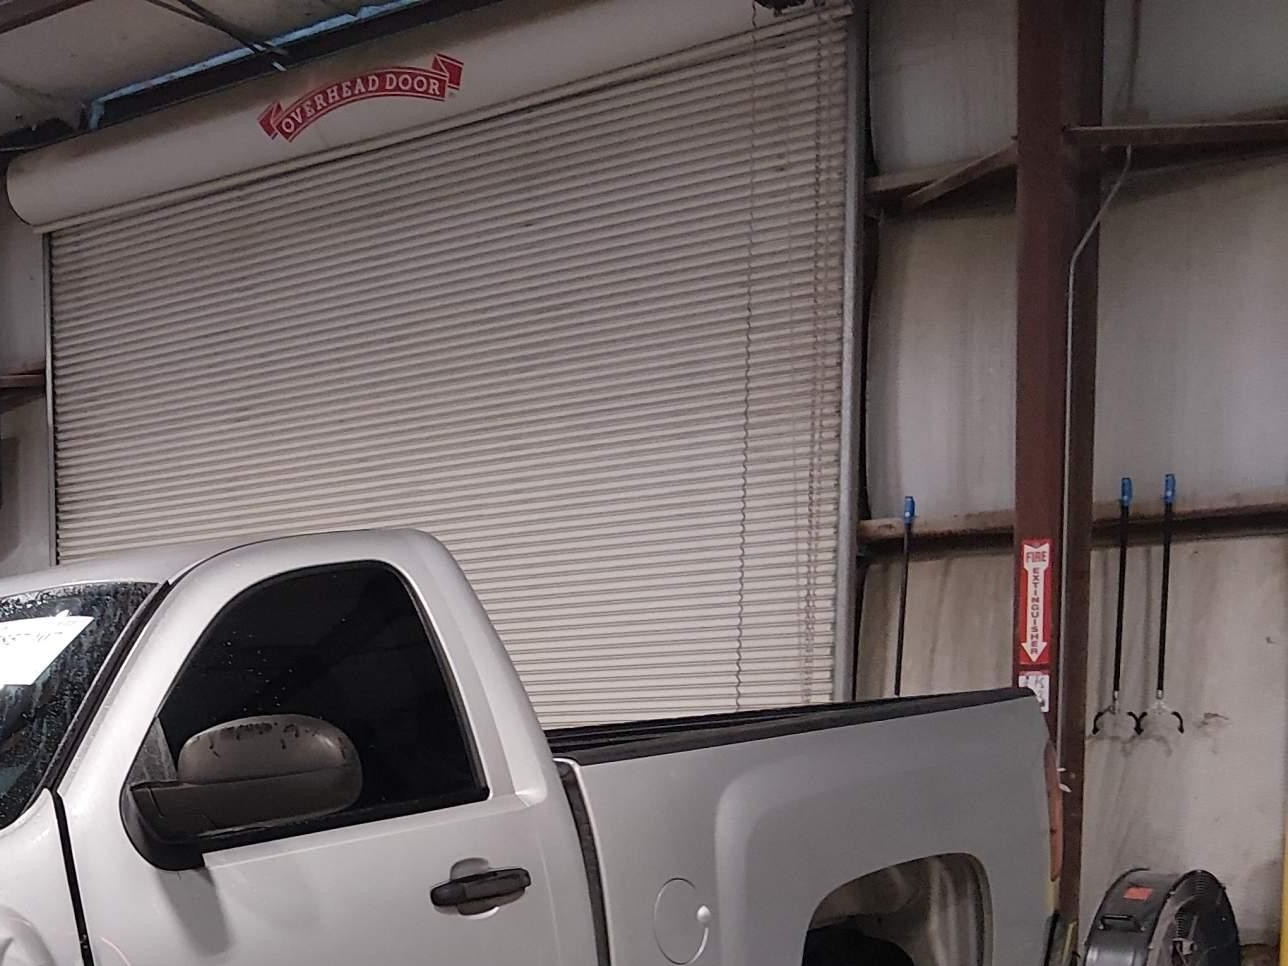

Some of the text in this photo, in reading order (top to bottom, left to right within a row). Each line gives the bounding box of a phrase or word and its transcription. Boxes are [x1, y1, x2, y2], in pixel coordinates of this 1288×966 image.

[282, 74, 441, 133] OVERHEAD DOOR
[1025, 551, 1047, 563] FIRE
[1030, 567, 1040, 655] EXTINGUISHER
